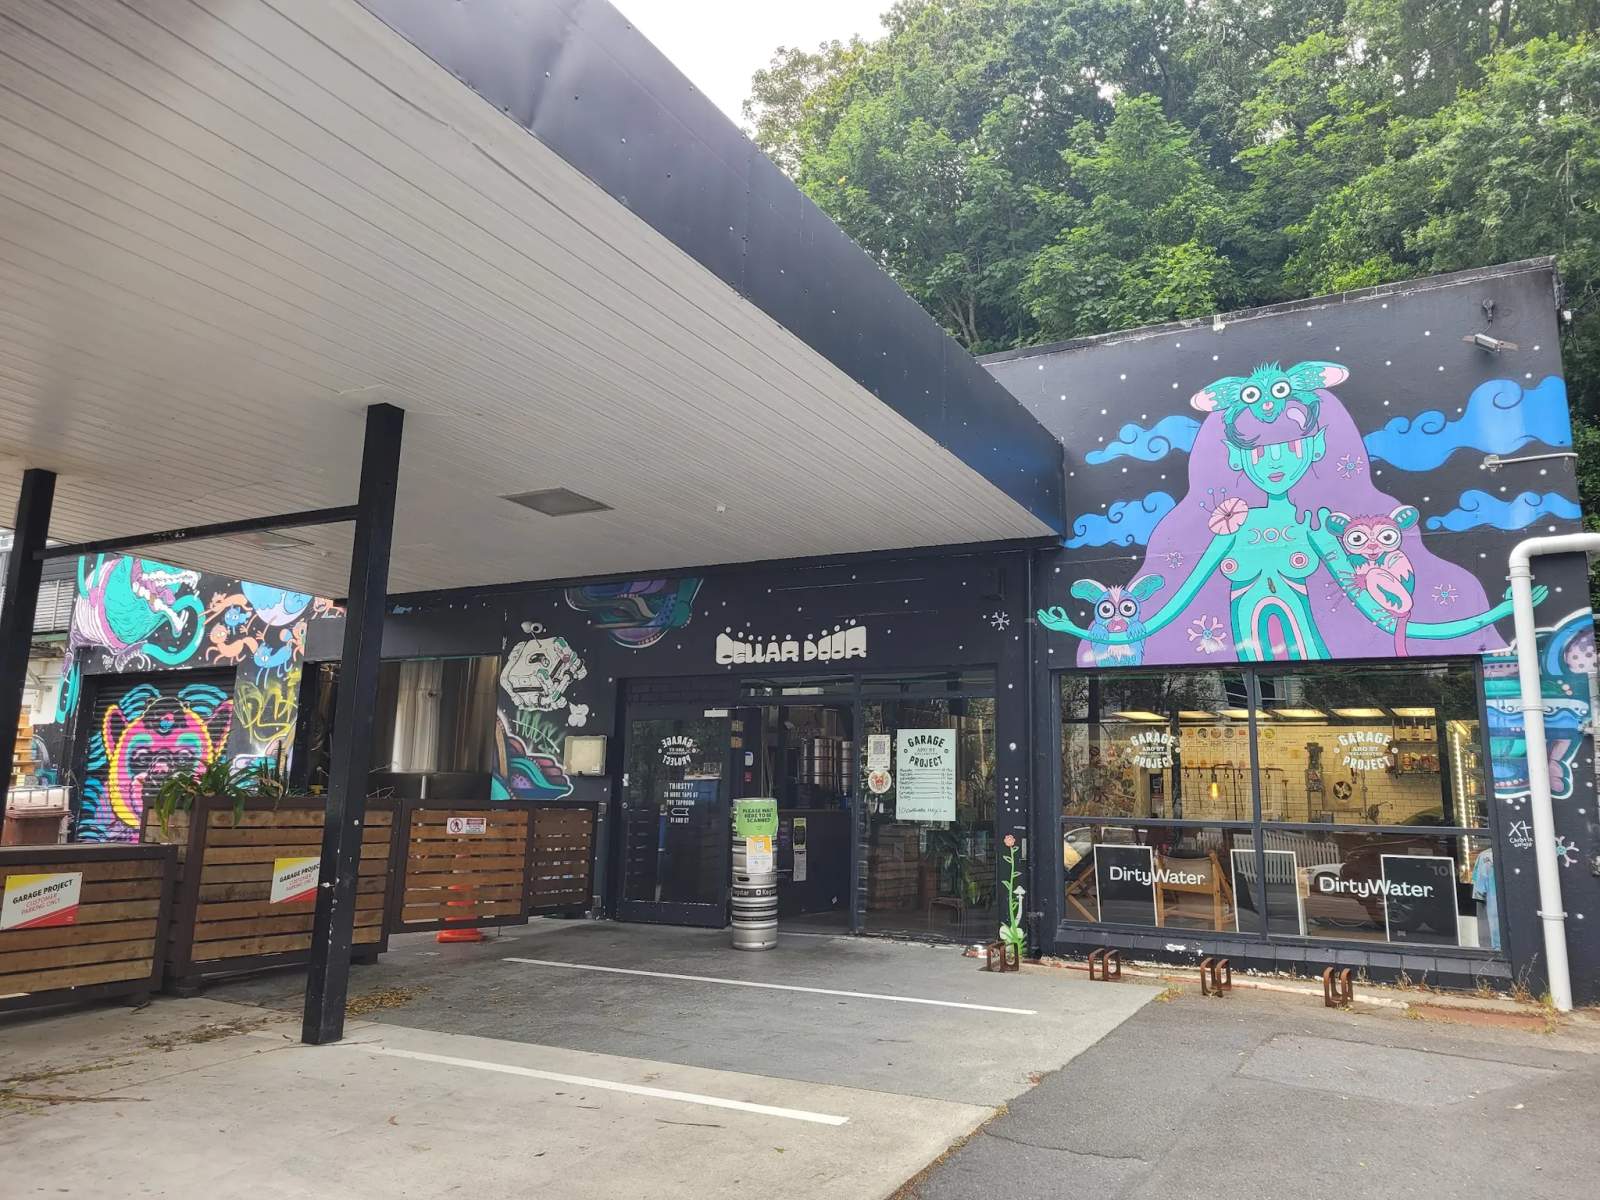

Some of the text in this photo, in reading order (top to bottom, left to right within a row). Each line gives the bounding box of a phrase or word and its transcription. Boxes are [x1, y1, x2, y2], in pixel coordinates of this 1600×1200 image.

[716, 625, 867, 664] CELLAR DOOR
[907, 735, 945, 748] GARAGE
[1130, 731, 1176, 746] GARAGE
[1338, 731, 1392, 746] GARAGE
[909, 755, 943, 768] PROJECT
[1133, 755, 1174, 769] PROJECT
[1342, 755, 1391, 770] PROJECT
[1109, 866, 1206, 886] DirtyWater
[12, 879, 74, 905] GARAGE PROJECT
[1319, 876, 1434, 898] DirtyWater
